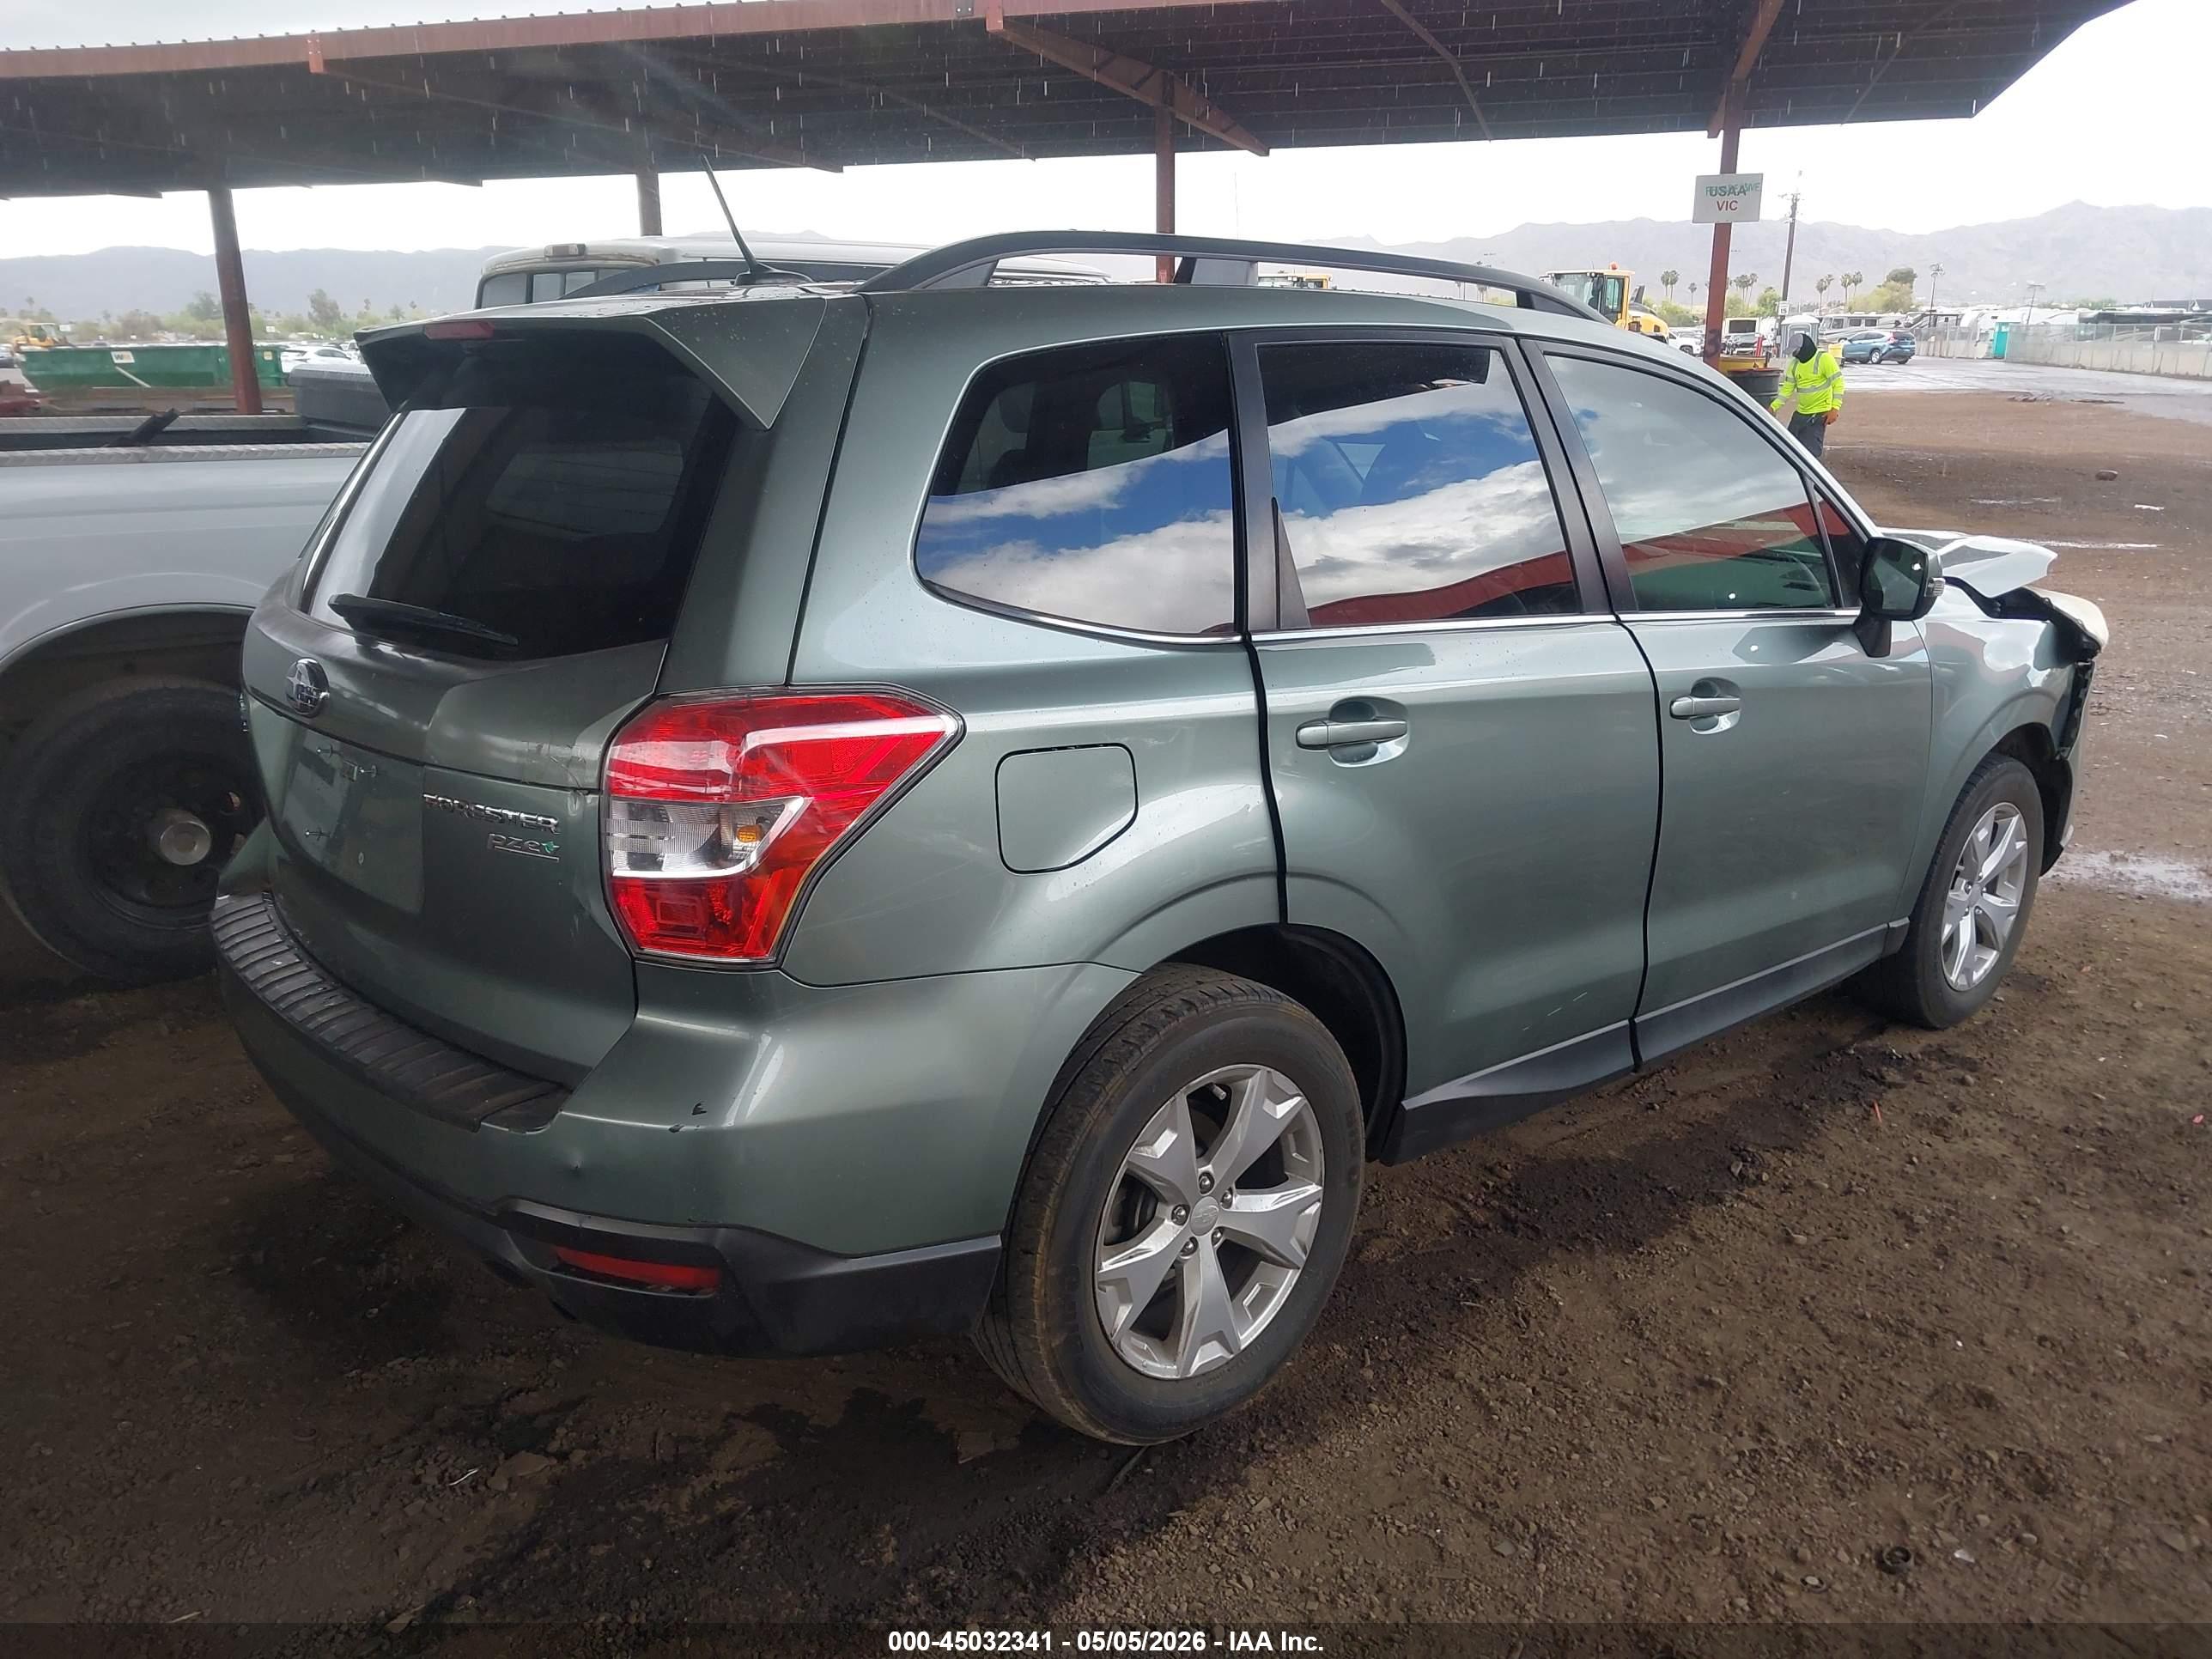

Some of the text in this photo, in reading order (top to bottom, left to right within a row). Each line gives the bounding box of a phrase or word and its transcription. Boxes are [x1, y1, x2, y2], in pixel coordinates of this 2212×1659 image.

[1709, 185, 1747, 197] USAA
[1717, 200, 1738, 211] VIC
[423, 793, 560, 835] FORESTER
